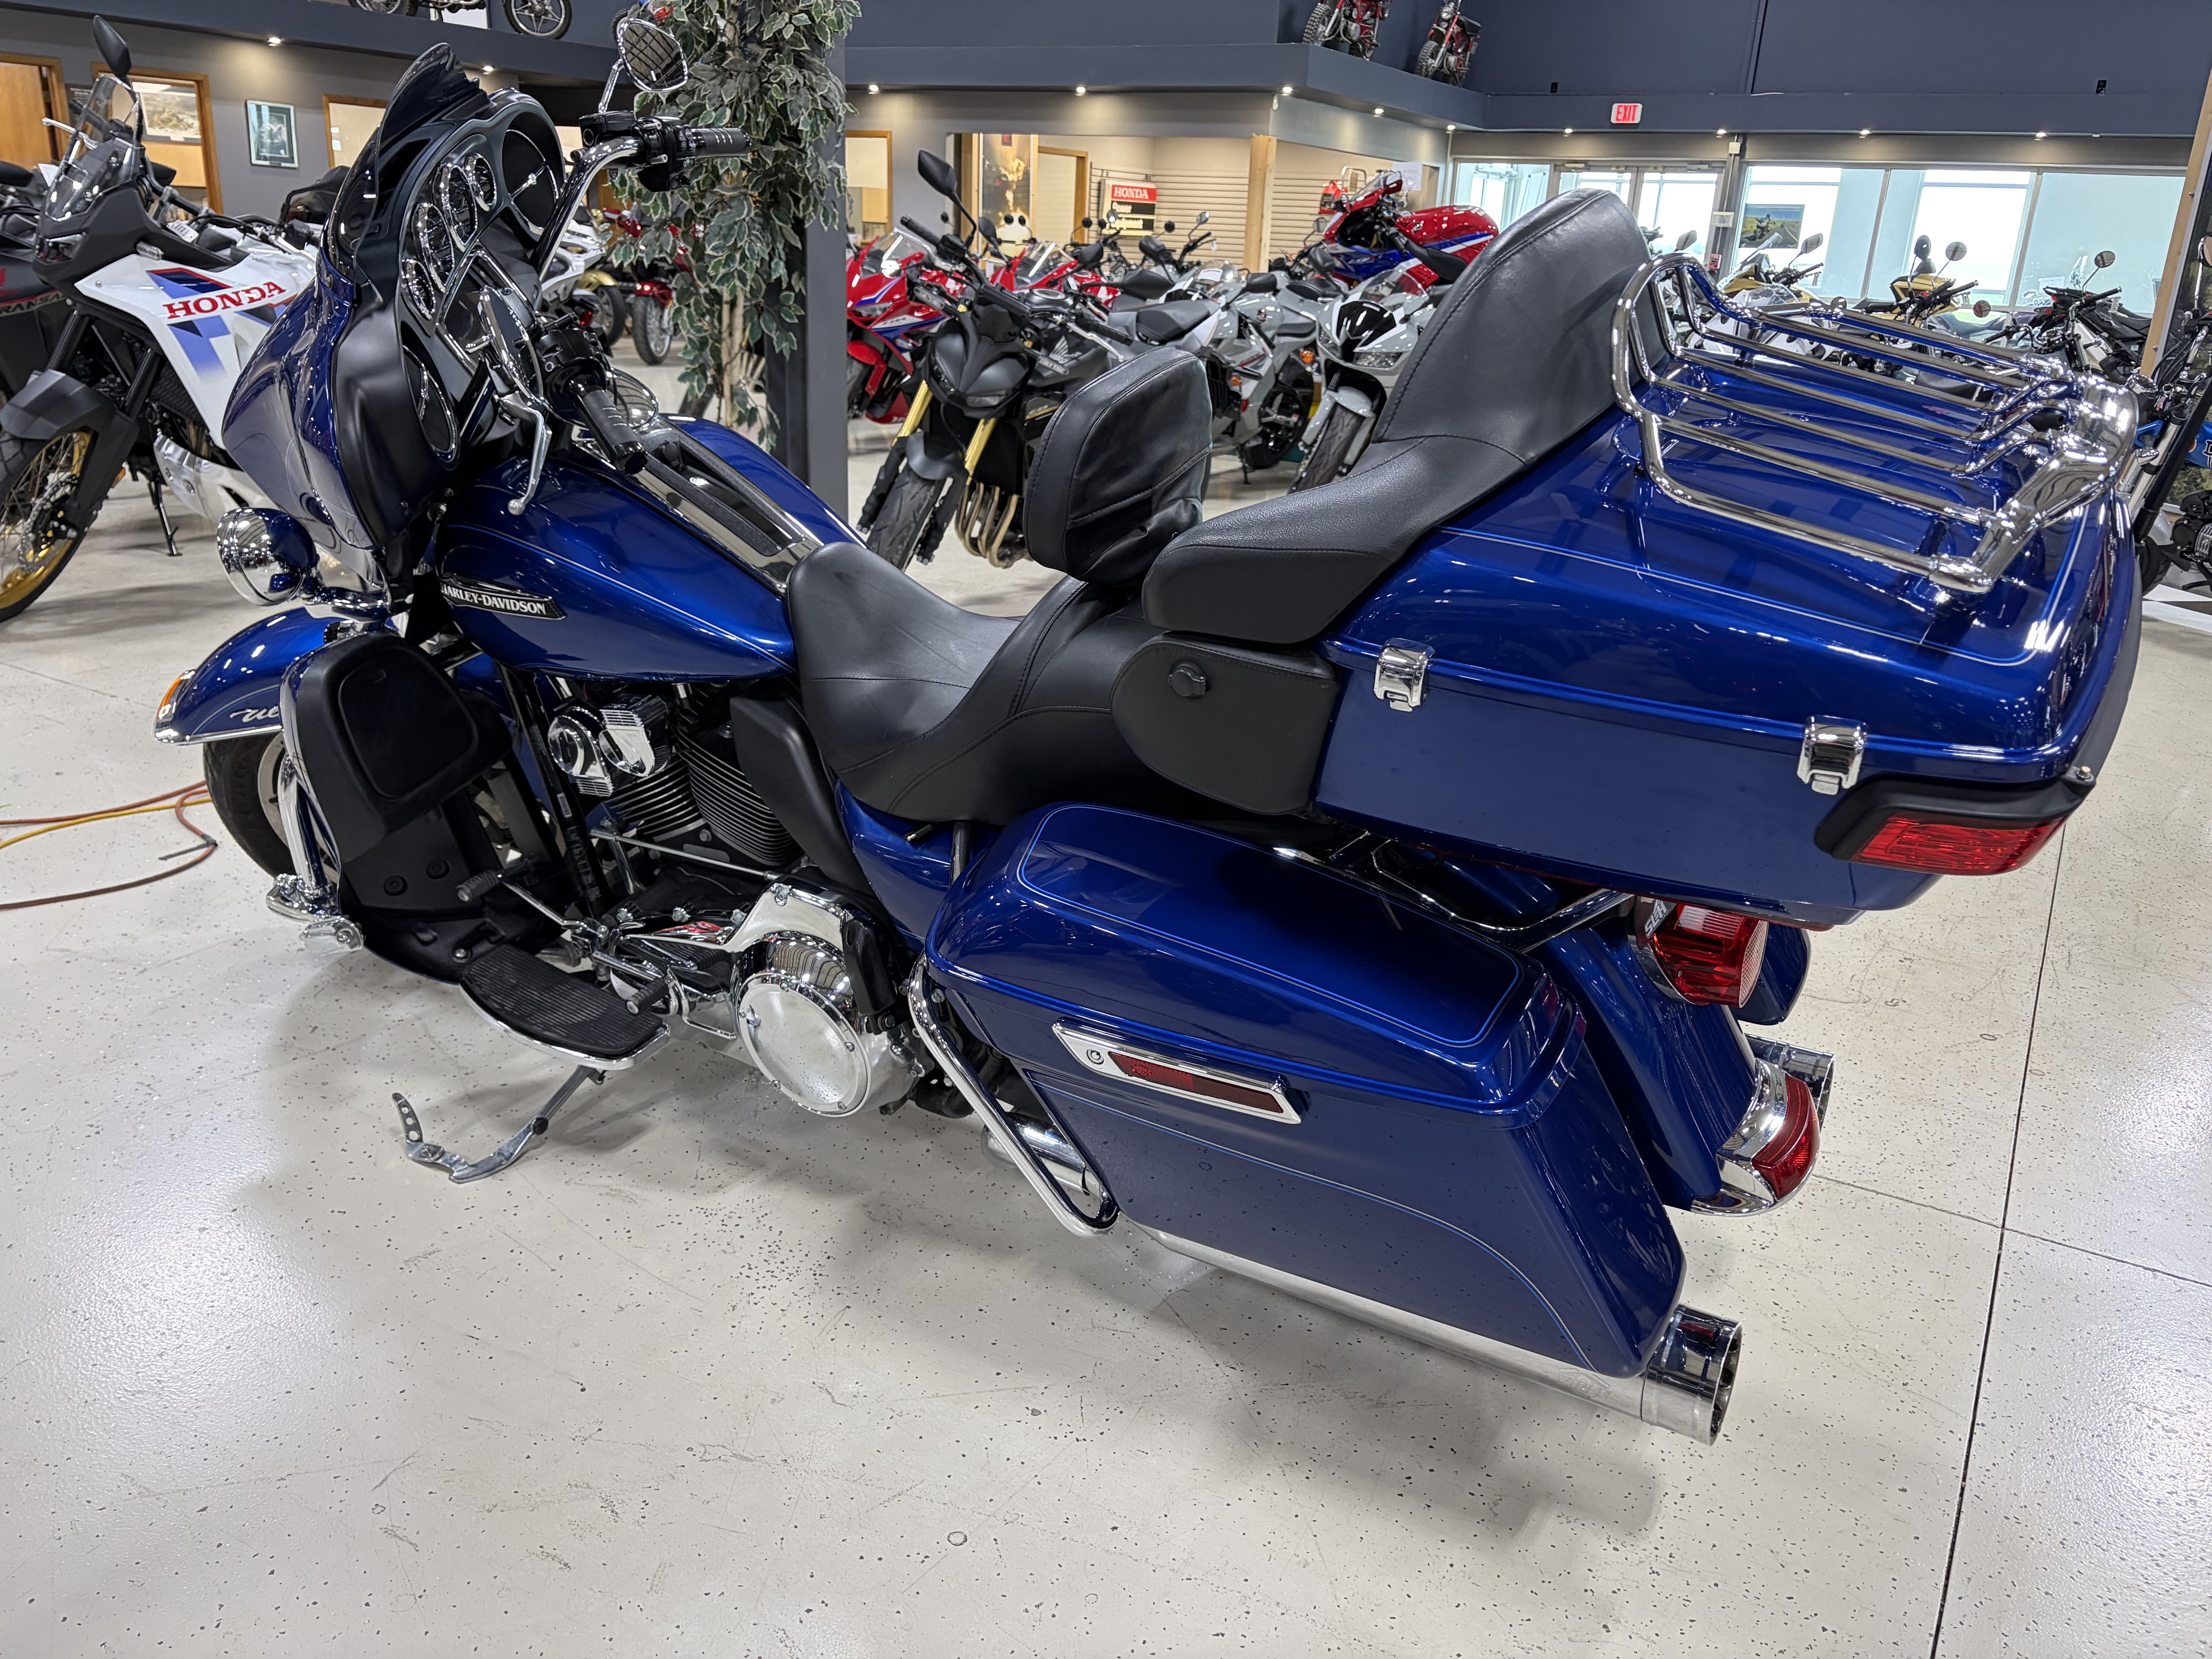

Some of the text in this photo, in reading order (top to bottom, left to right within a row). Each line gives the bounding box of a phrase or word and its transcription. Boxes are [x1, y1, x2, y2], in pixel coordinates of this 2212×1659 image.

[1616, 105, 1638, 121] EXIT
[1114, 187, 1149, 199] HONDA
[162, 281, 286, 319] HONDA
[441, 584, 546, 615] HARLEY-DAVIDSON
